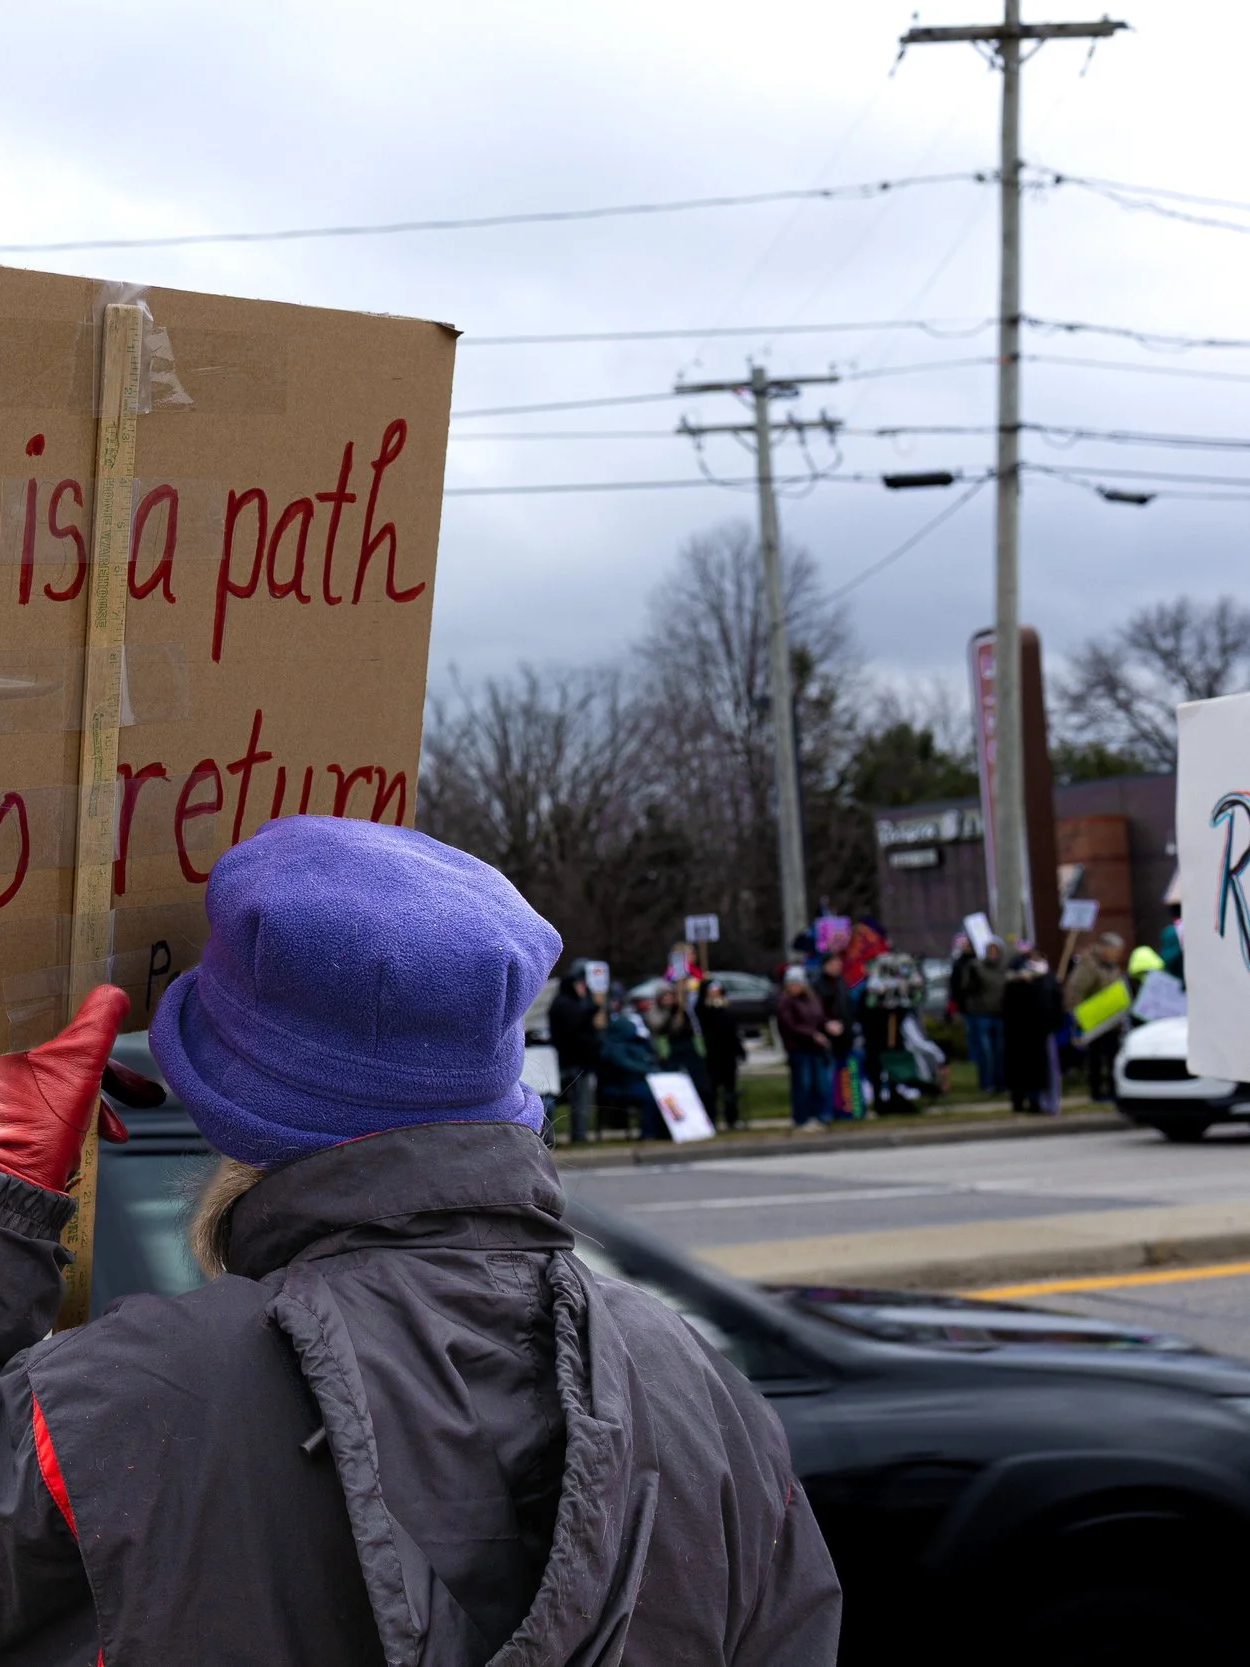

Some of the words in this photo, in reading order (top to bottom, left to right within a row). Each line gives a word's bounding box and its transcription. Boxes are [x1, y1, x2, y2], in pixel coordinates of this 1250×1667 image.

[18, 433, 84, 605] is
[128, 484, 179, 605] a
[212, 418, 427, 663] path
[102, 477, 114, 525] HOME
[95, 529, 112, 629] WAREHOUSE
